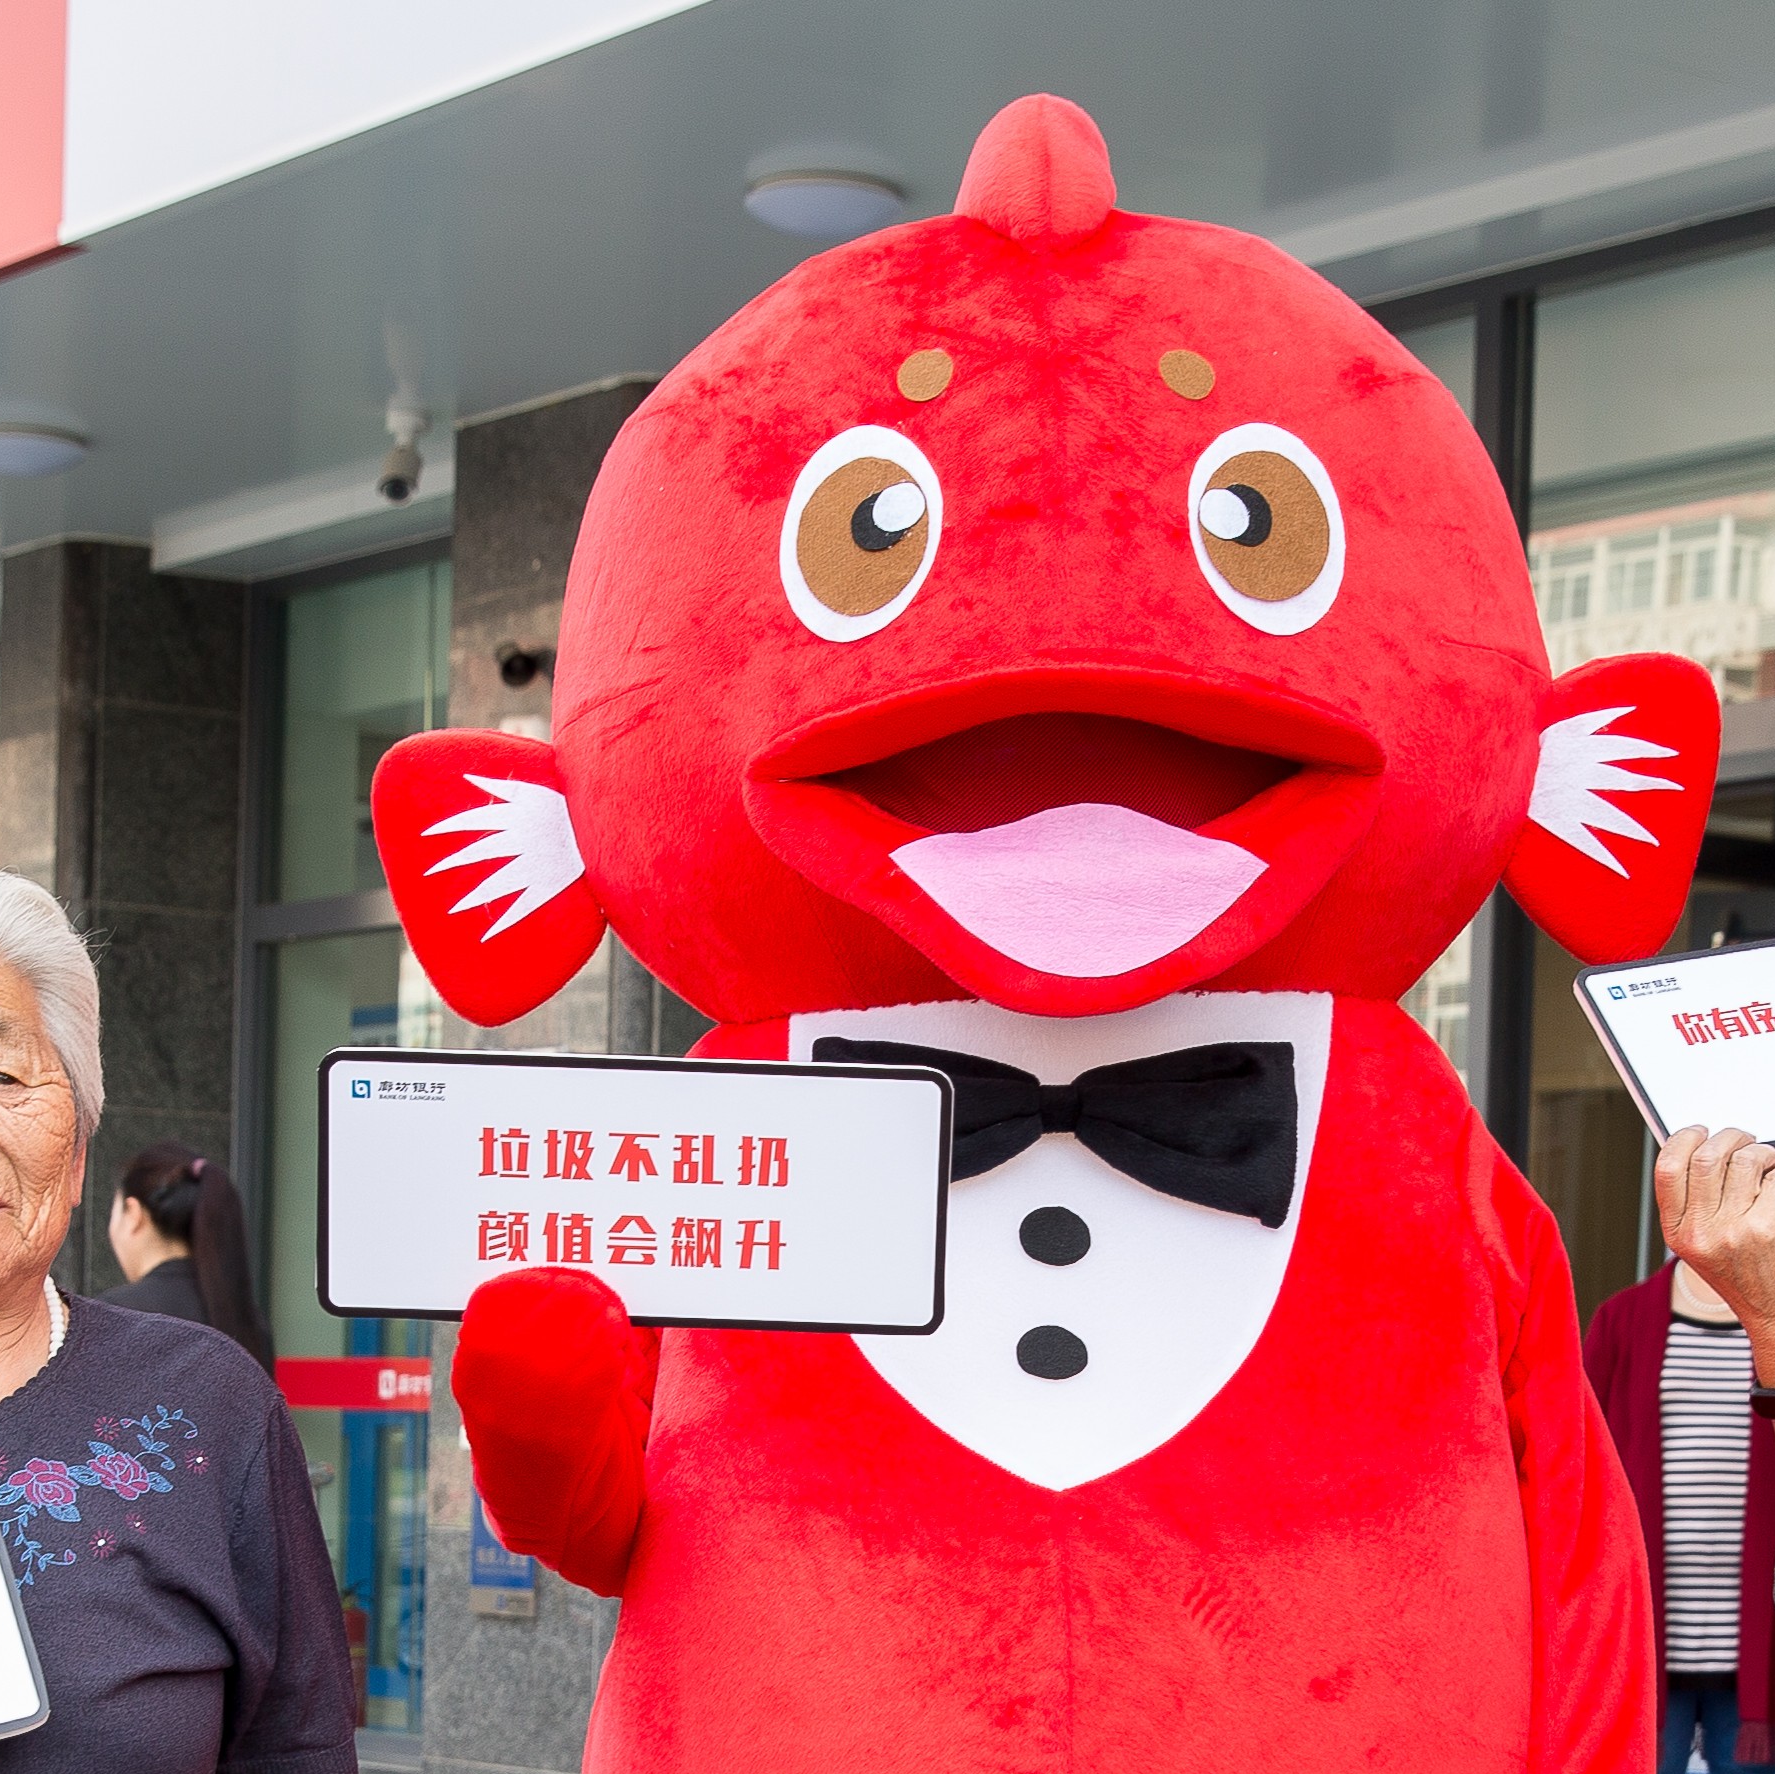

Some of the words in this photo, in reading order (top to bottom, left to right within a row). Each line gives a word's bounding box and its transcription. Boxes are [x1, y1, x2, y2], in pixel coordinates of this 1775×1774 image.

[378, 1081, 447, 1094] 廊坊银行
[478, 1127, 789, 1187] 垃圾不乱扔
[478, 1210, 787, 1270] 颜值会飙升
